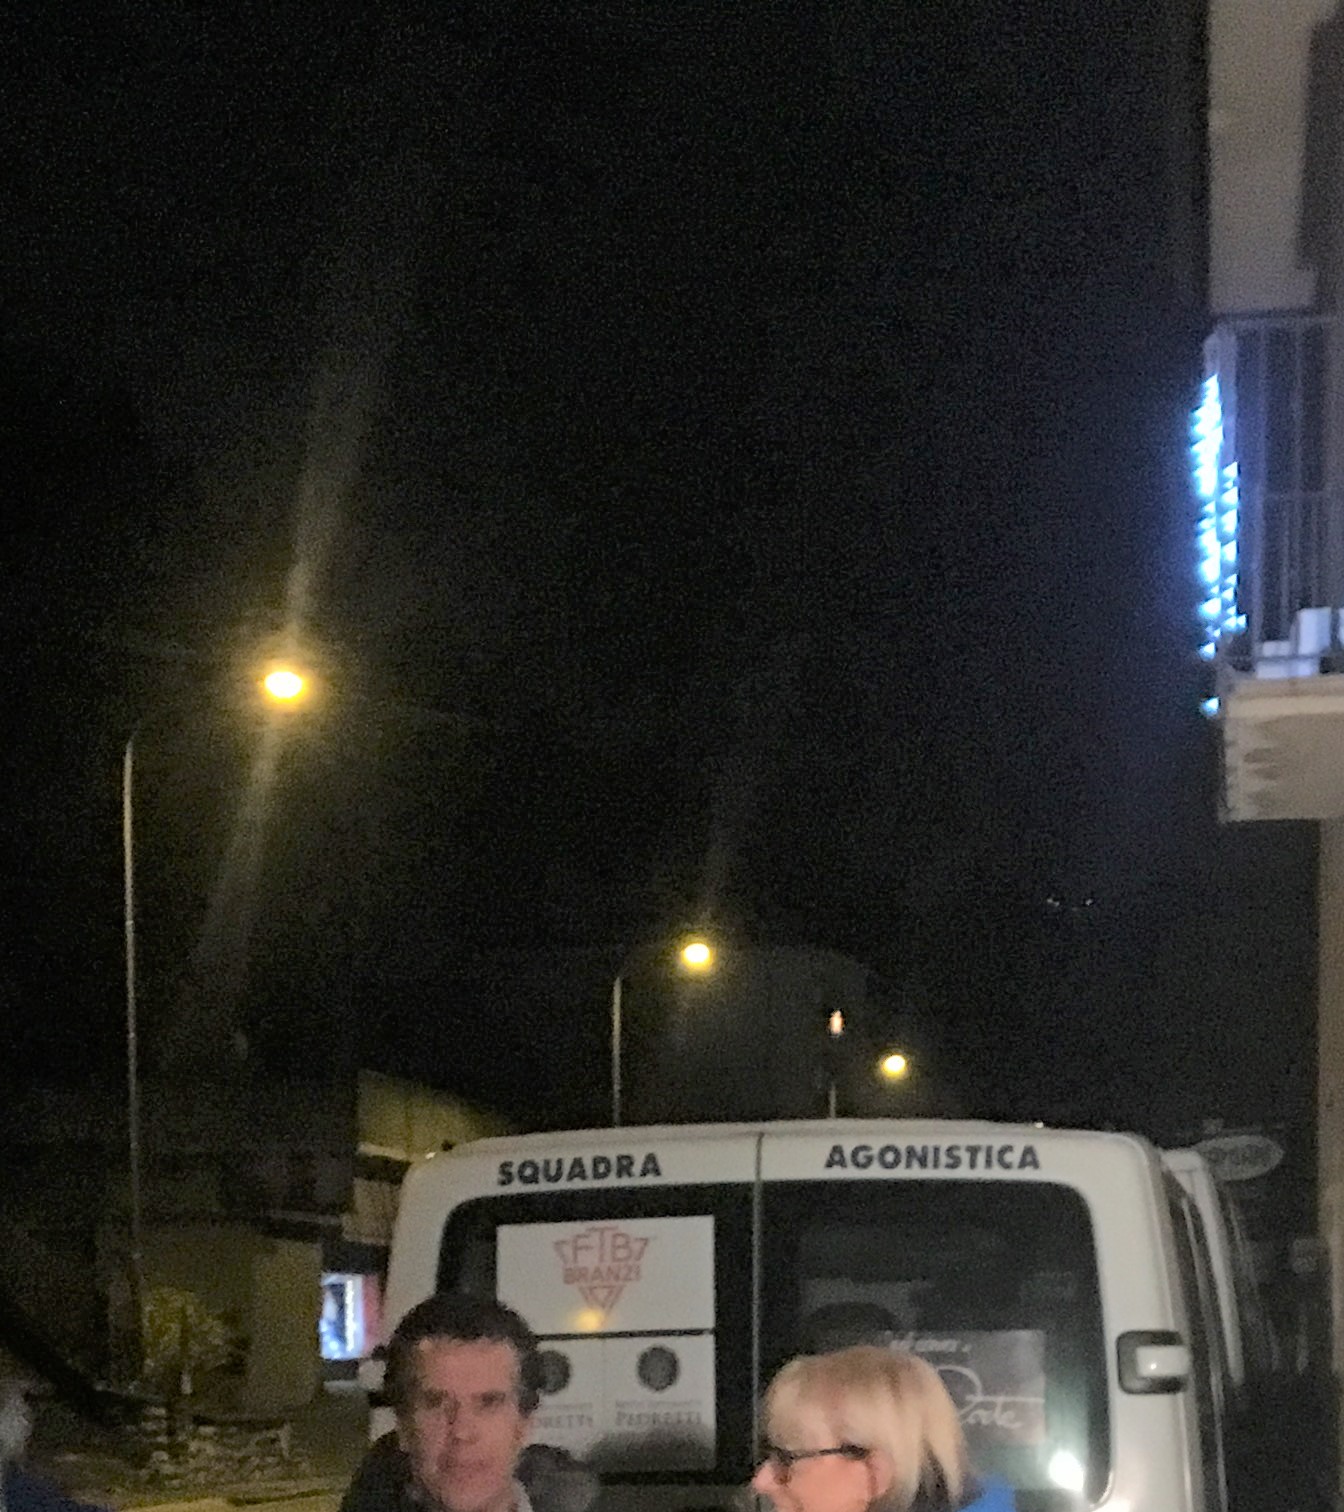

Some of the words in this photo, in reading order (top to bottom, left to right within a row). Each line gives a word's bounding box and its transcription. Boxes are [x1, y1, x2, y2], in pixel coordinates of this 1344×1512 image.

[497, 1152, 663, 1187] SQUADRA
[824, 1143, 1041, 1171] AGONISTICA
[571, 1226, 633, 1264] FTB
